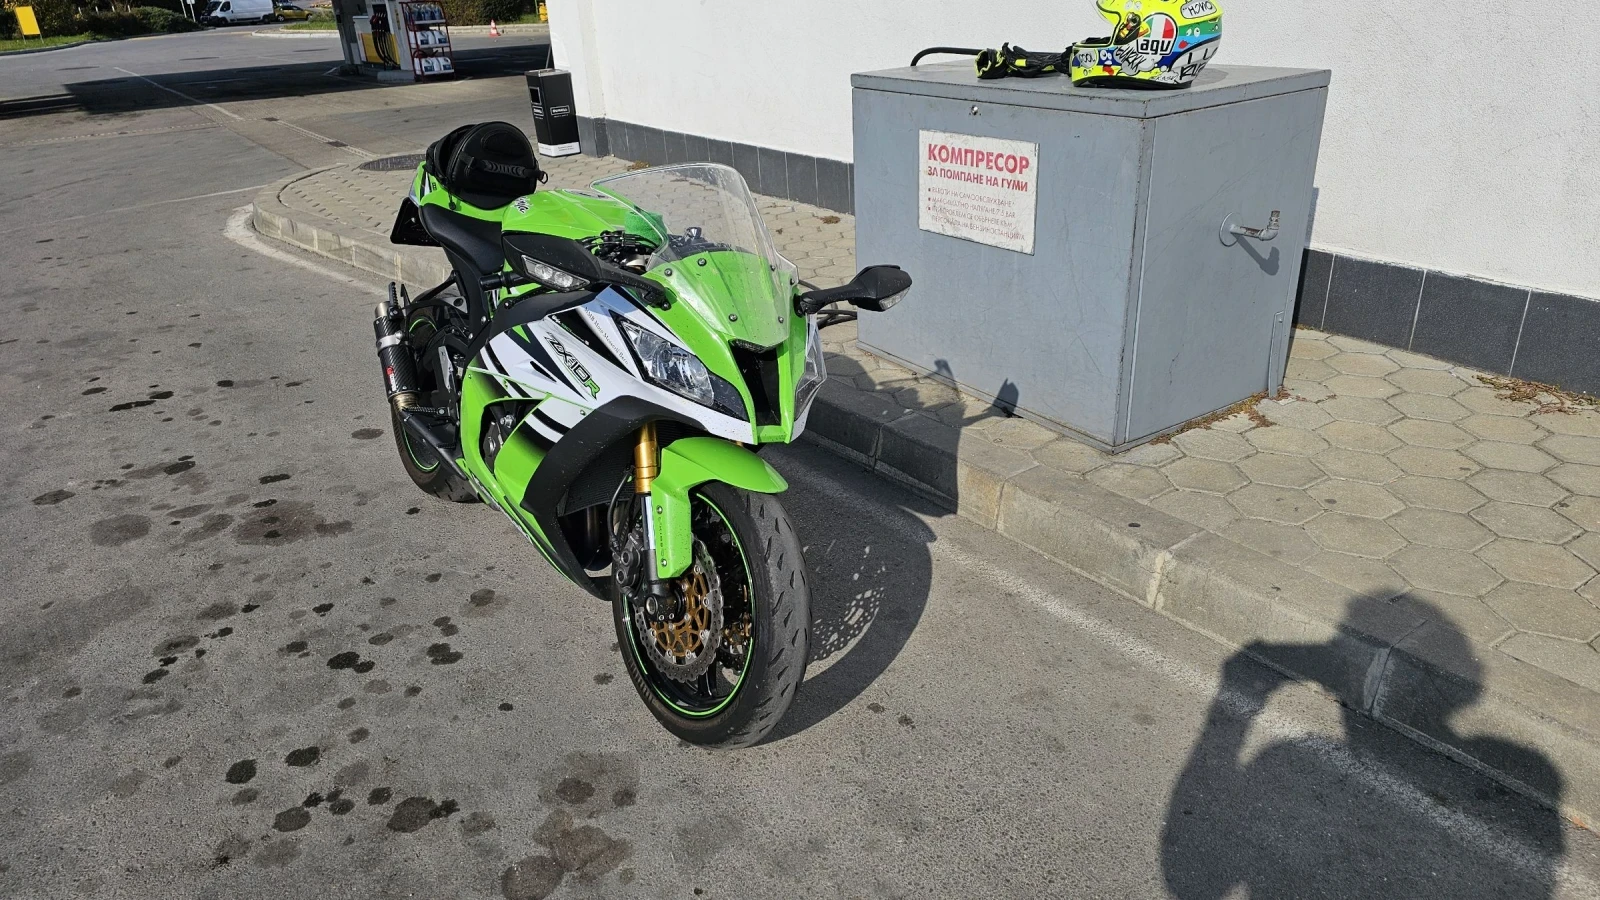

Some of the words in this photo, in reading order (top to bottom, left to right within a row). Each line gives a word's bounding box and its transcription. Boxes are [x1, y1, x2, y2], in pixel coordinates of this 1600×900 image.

[1140, 39, 1171, 54] agv
[928, 143, 1030, 174] КОМПРЕСОР
[927, 165, 938, 176] ЗА
[940, 168, 984, 185] ПОМПАНЕ
[986, 175, 999, 187] НА
[1001, 178, 1028, 192] ГУМИ
[545, 333, 601, 400] ZX-10R
